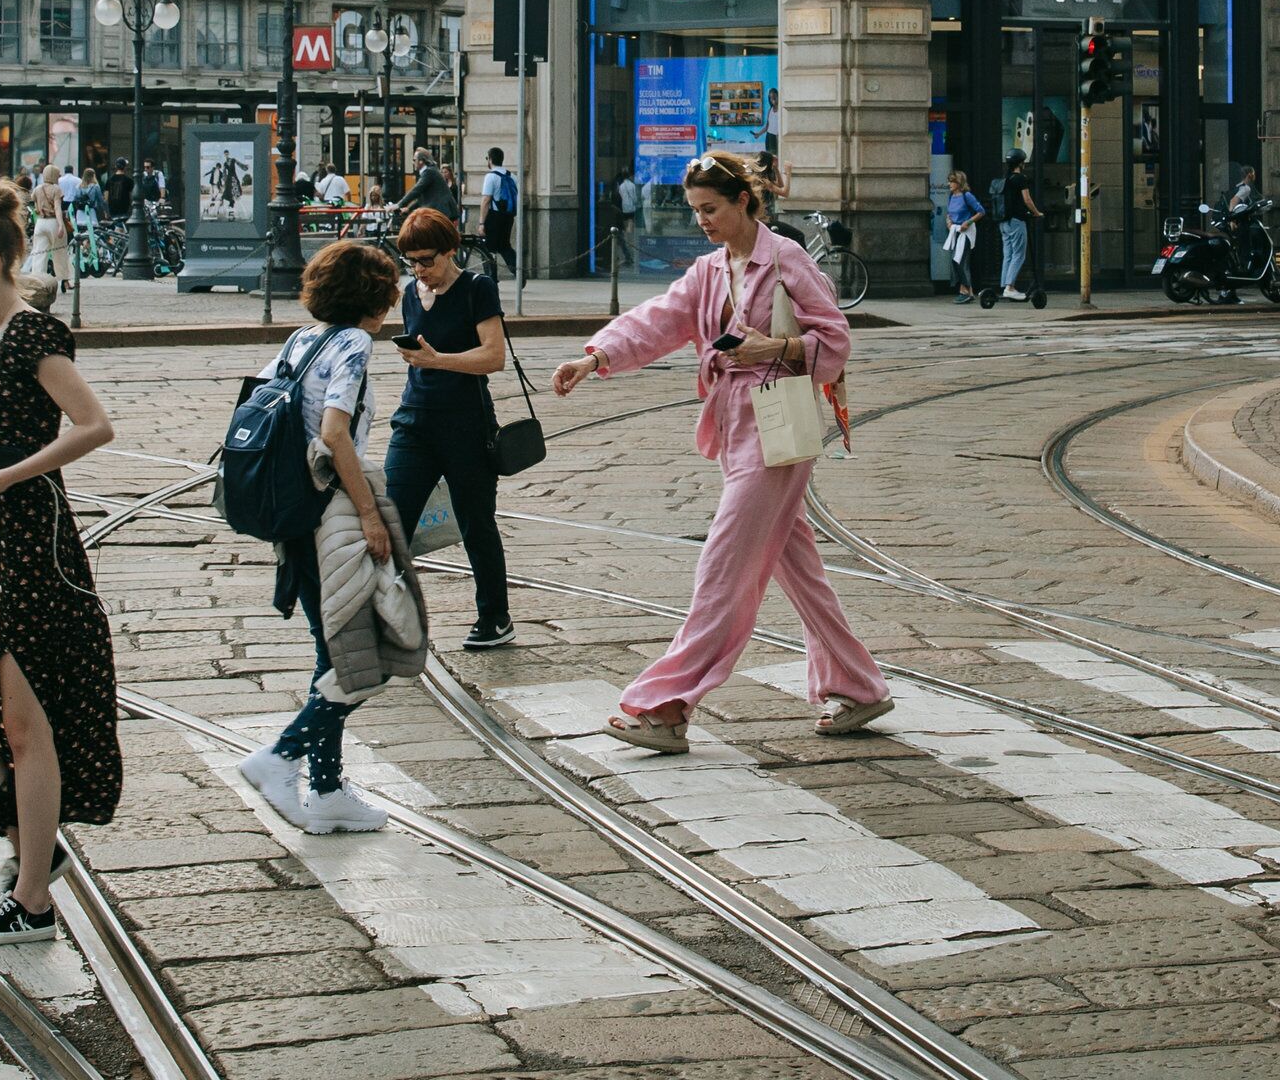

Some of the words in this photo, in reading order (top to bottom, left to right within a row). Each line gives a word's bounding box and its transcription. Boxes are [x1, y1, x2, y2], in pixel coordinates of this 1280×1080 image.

[873, 21, 918, 30] BROLETTO
[295, 35, 331, 62] M
[648, 65, 663, 76] TIM
